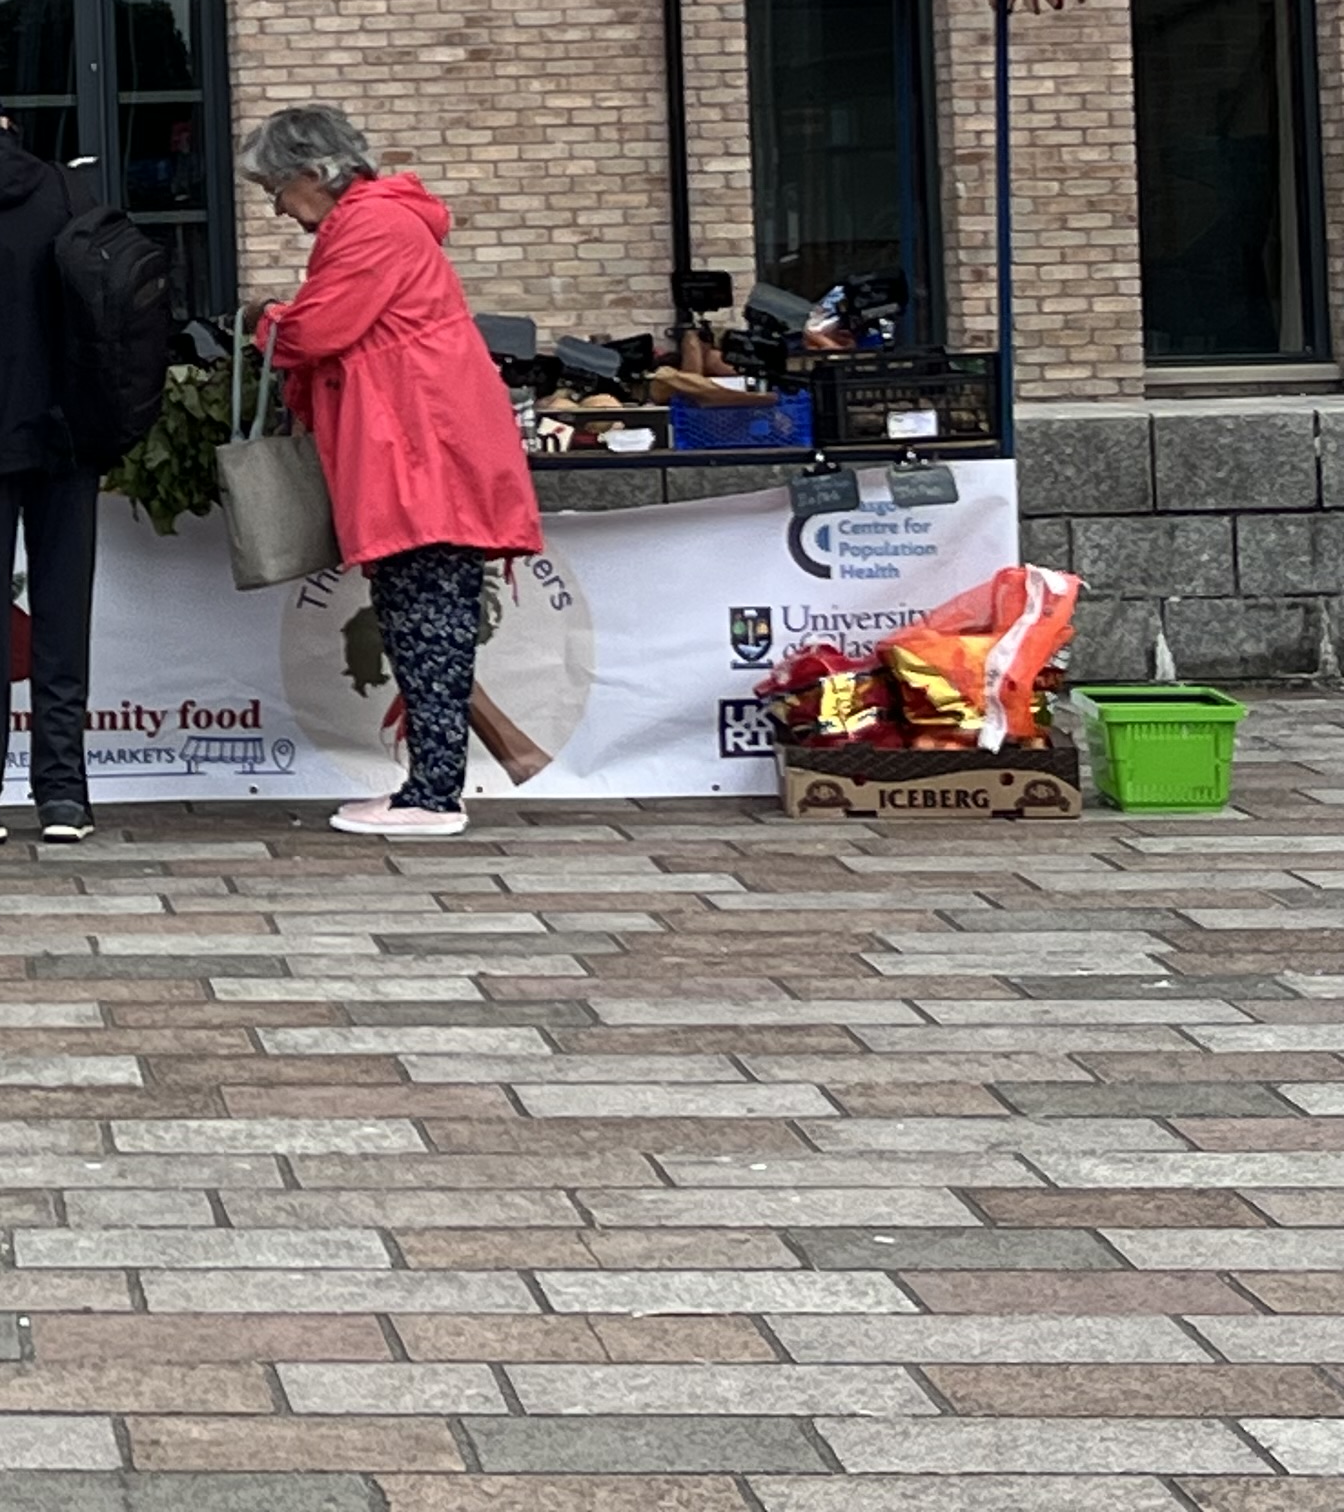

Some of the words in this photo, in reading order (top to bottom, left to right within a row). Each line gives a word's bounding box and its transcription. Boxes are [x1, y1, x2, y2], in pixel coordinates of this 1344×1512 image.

[838, 519, 899, 535] Centre
[903, 517, 932, 534] for
[838, 542, 939, 560] Population
[839, 563, 901, 580] Health
[781, 603, 932, 633] University
[177, 699, 262, 731] food
[87, 748, 176, 765] MARKETS
[878, 789, 990, 809] ICEBERG
